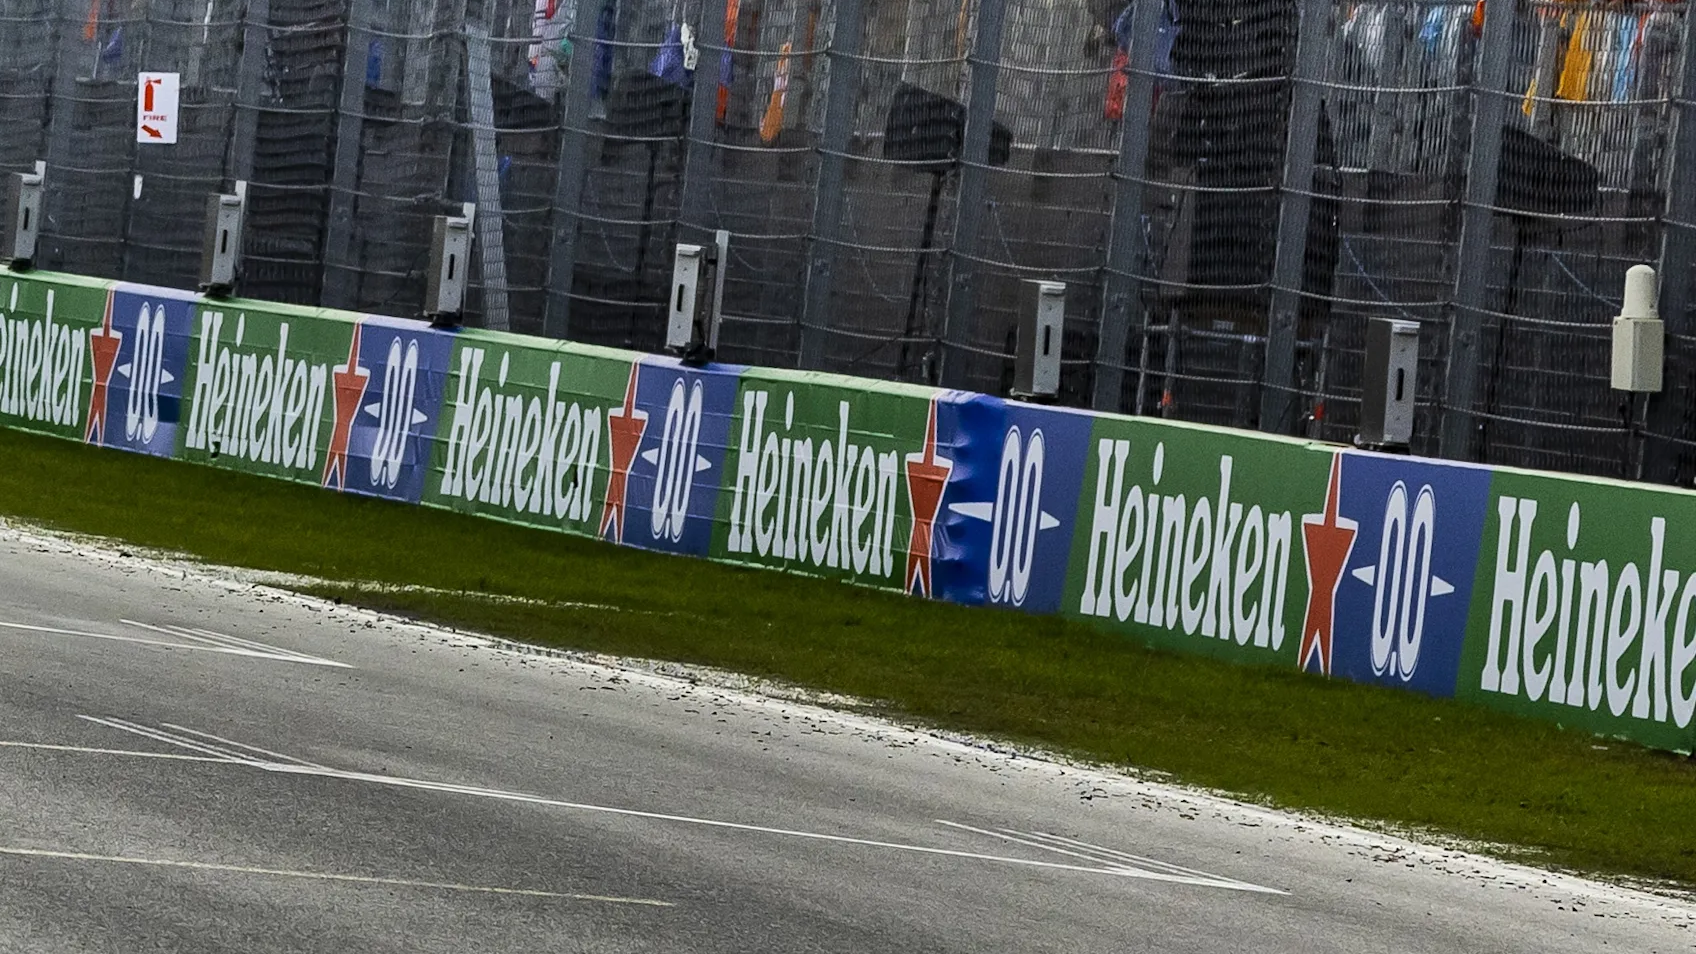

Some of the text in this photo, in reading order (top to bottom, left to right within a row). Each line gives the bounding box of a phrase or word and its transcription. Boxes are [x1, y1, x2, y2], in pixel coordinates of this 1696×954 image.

[186, 311, 327, 470] Heineken
[441, 348, 601, 522] Heineken
[728, 390, 898, 578] Heineken
[1080, 439, 1435, 681] Heineken 0.0
[1481, 496, 1696, 729] Heineke
